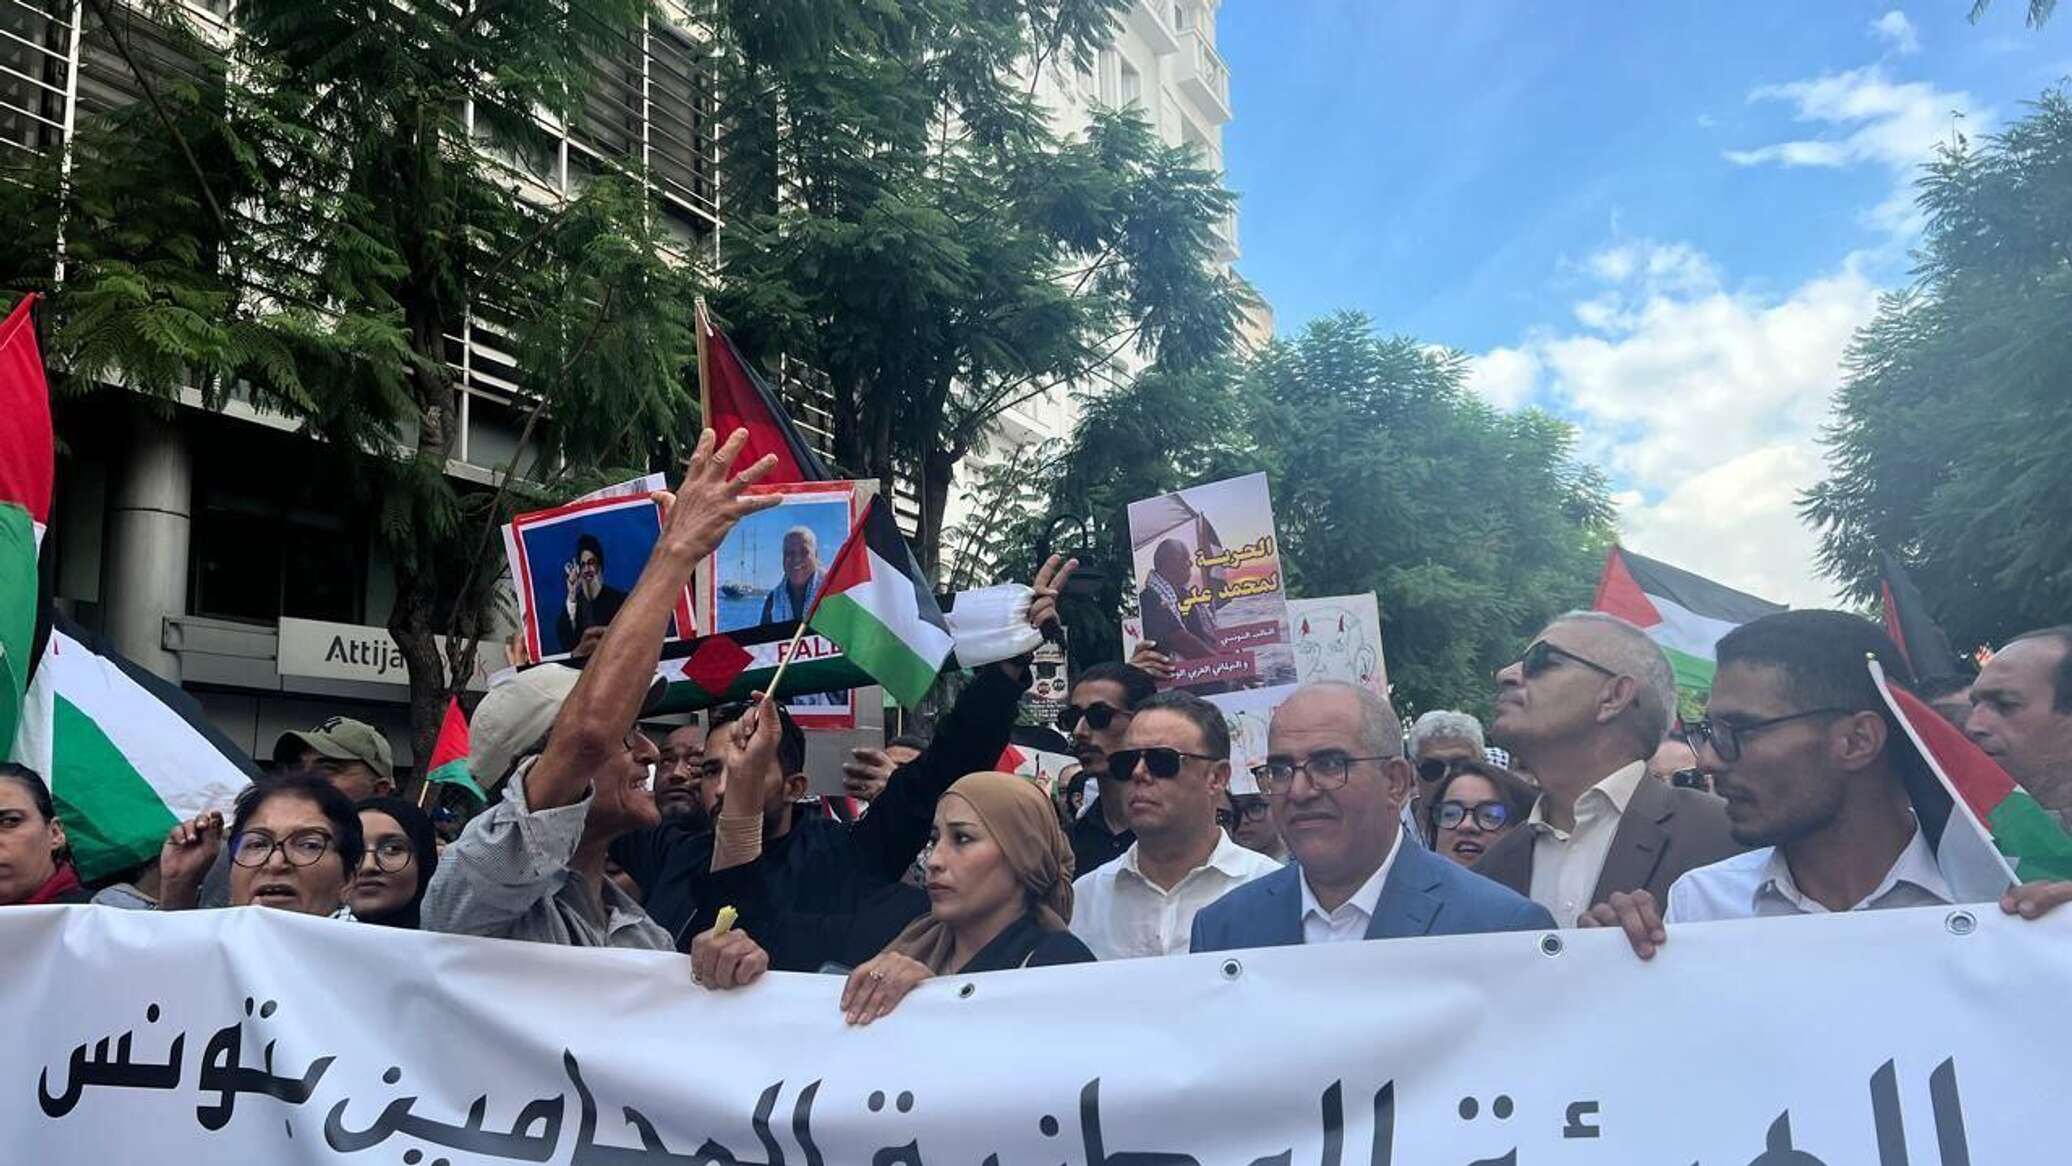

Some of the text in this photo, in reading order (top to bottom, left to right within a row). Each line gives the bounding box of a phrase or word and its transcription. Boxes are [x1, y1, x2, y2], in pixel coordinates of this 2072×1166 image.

[1178, 571, 1279, 616] لمحمد علي
[325, 634, 405, 675] Attija
[38, 996, 337, 1139] بتونس
